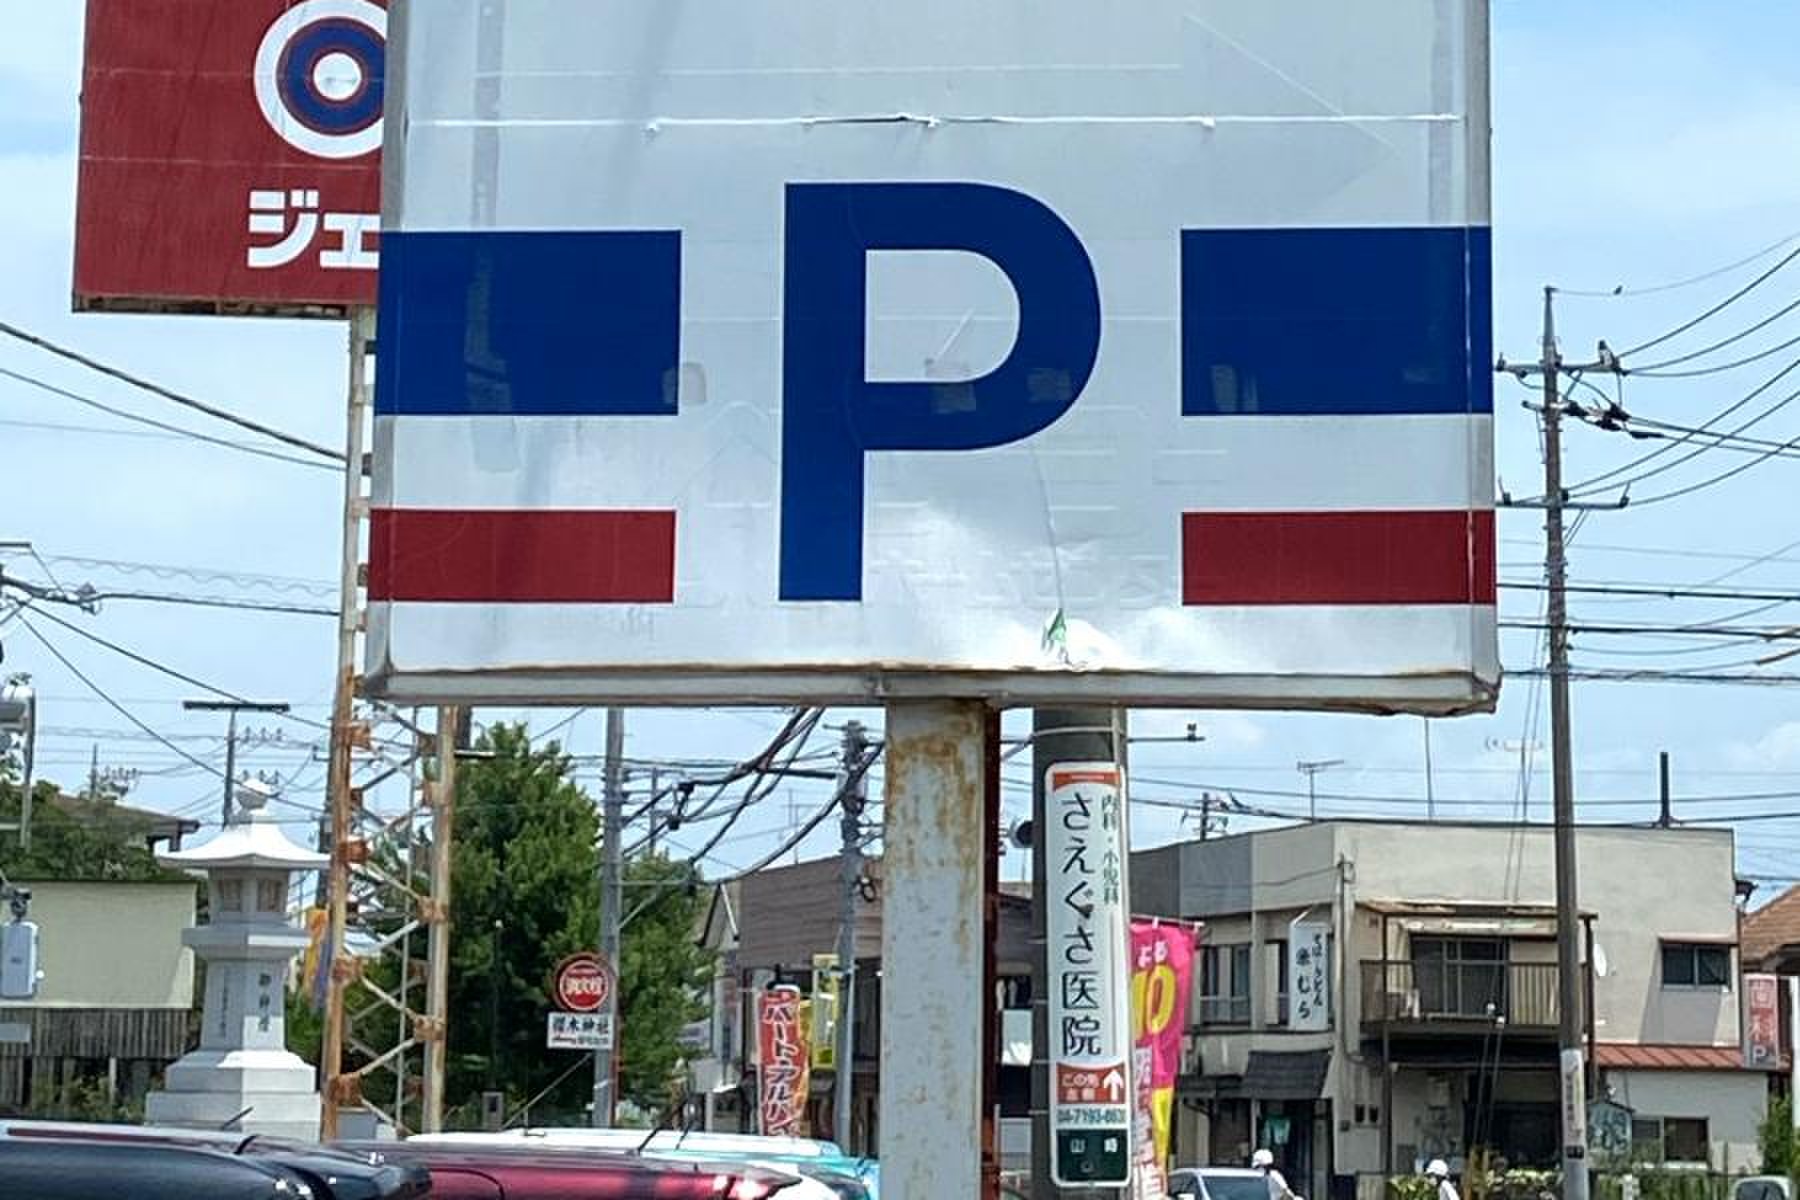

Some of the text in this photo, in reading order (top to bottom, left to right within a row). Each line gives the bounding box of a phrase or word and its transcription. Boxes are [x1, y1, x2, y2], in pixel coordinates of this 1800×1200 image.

[779, 181, 1102, 601] P
[1060, 792, 1102, 1057] さえぐさ医院
